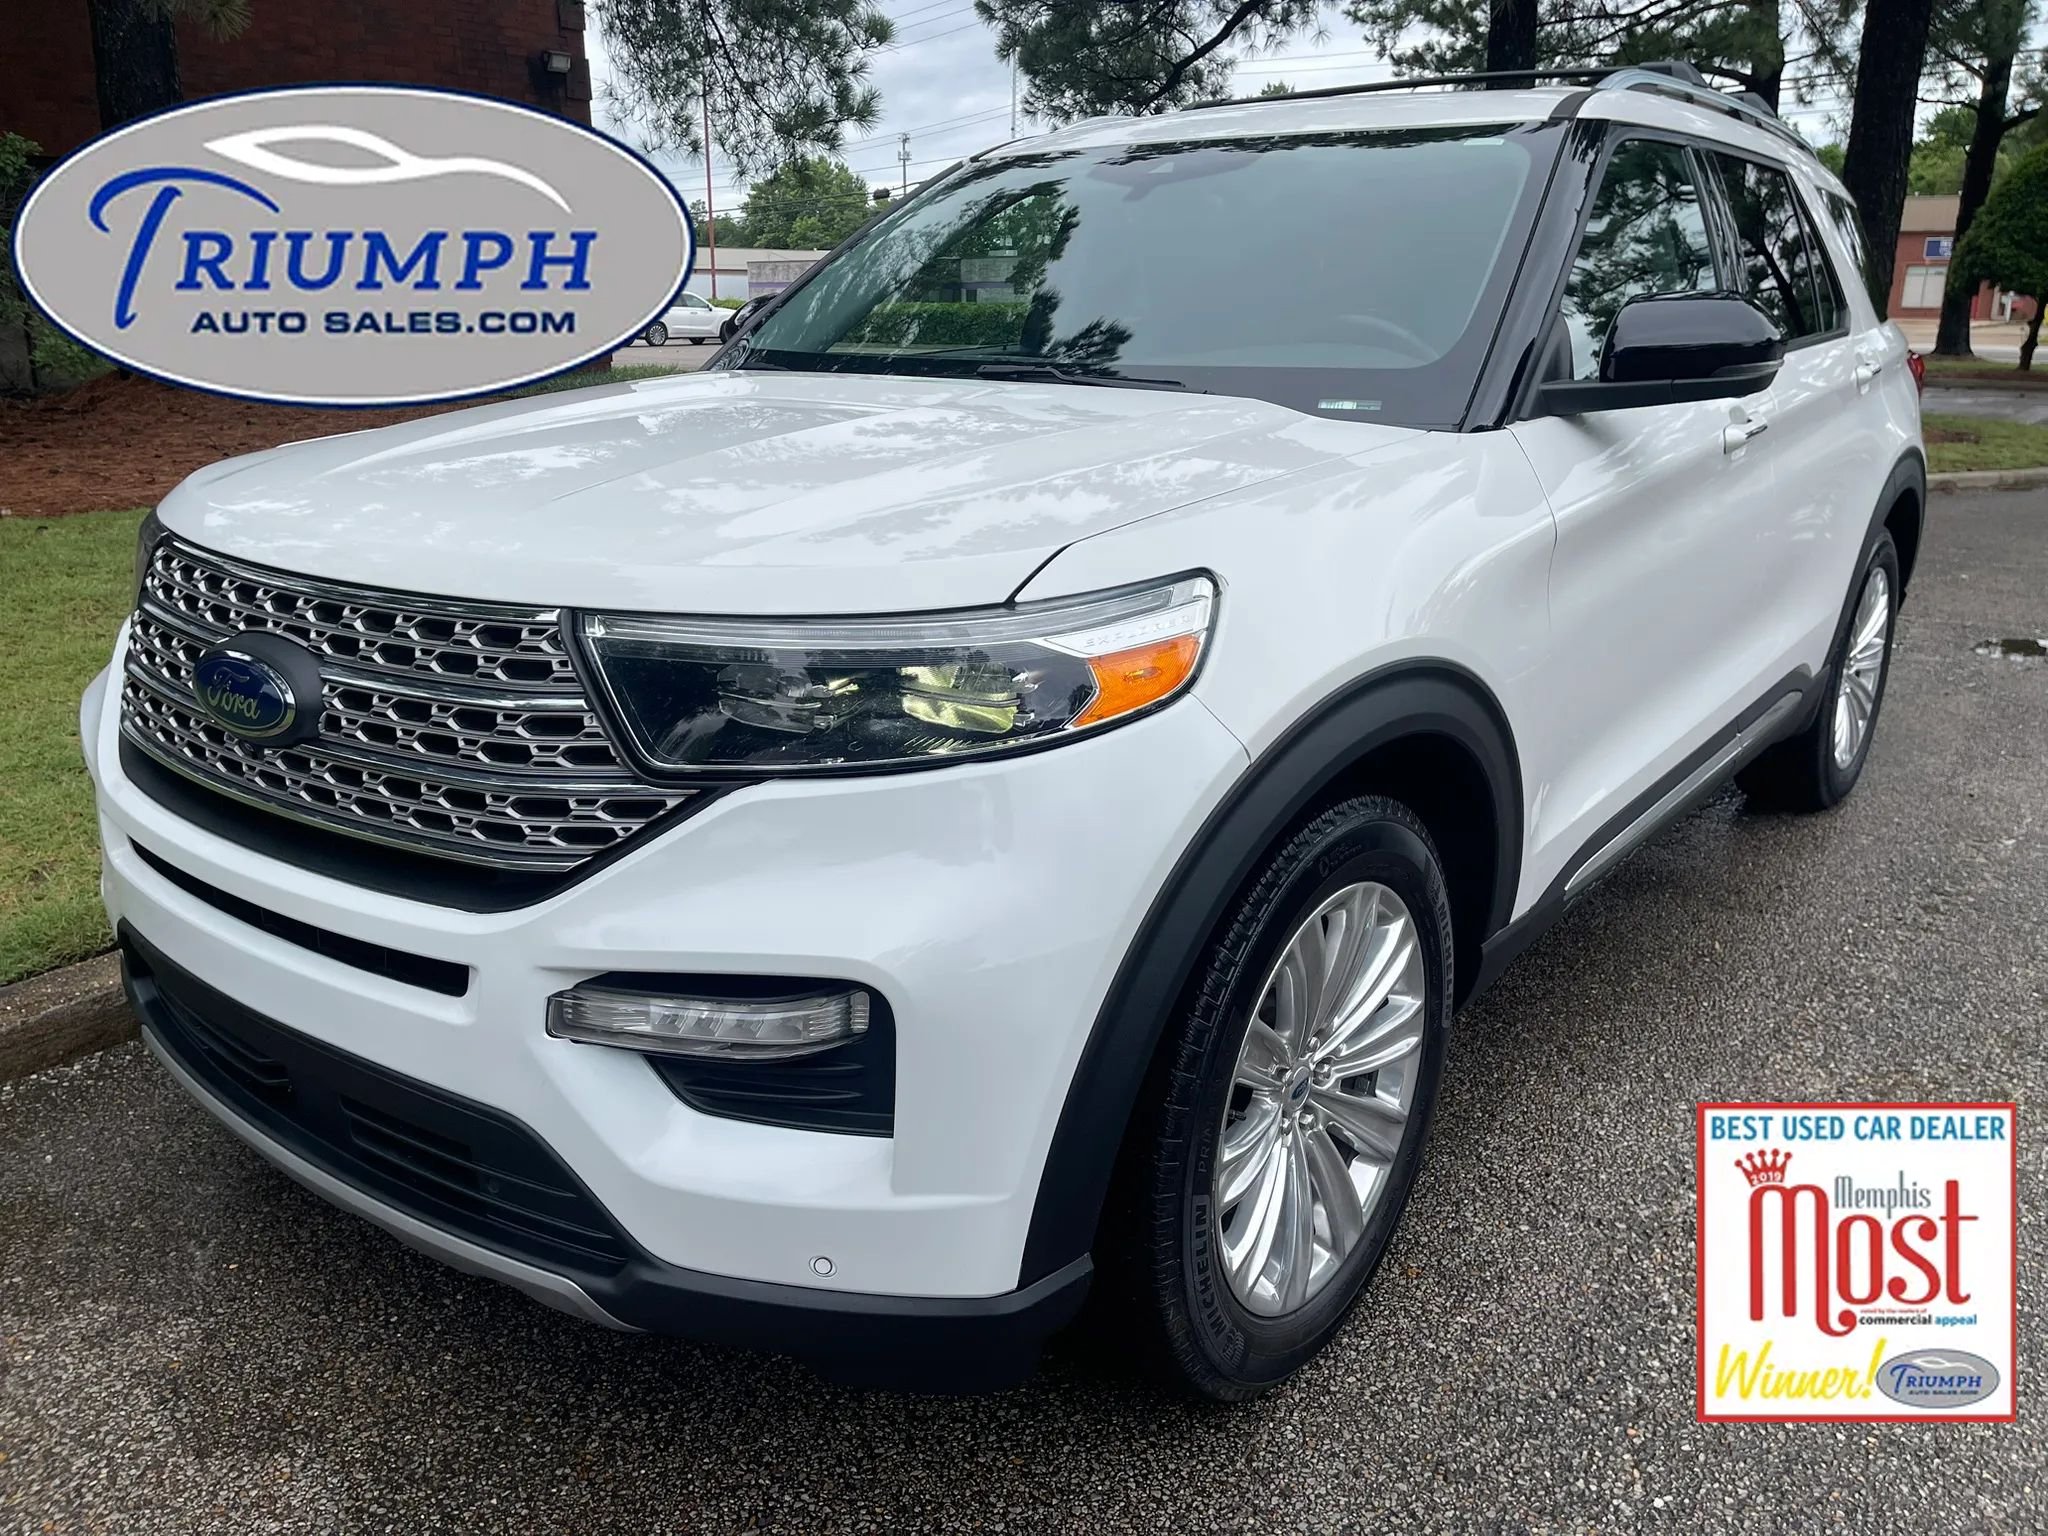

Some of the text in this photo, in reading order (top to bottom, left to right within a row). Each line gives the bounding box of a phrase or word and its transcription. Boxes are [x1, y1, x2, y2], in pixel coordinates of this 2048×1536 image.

[207, 666, 263, 720] Ford
[1437, 902, 1453, 1020] MICHELIN
[1194, 1204, 1228, 1341] MICHELIN
